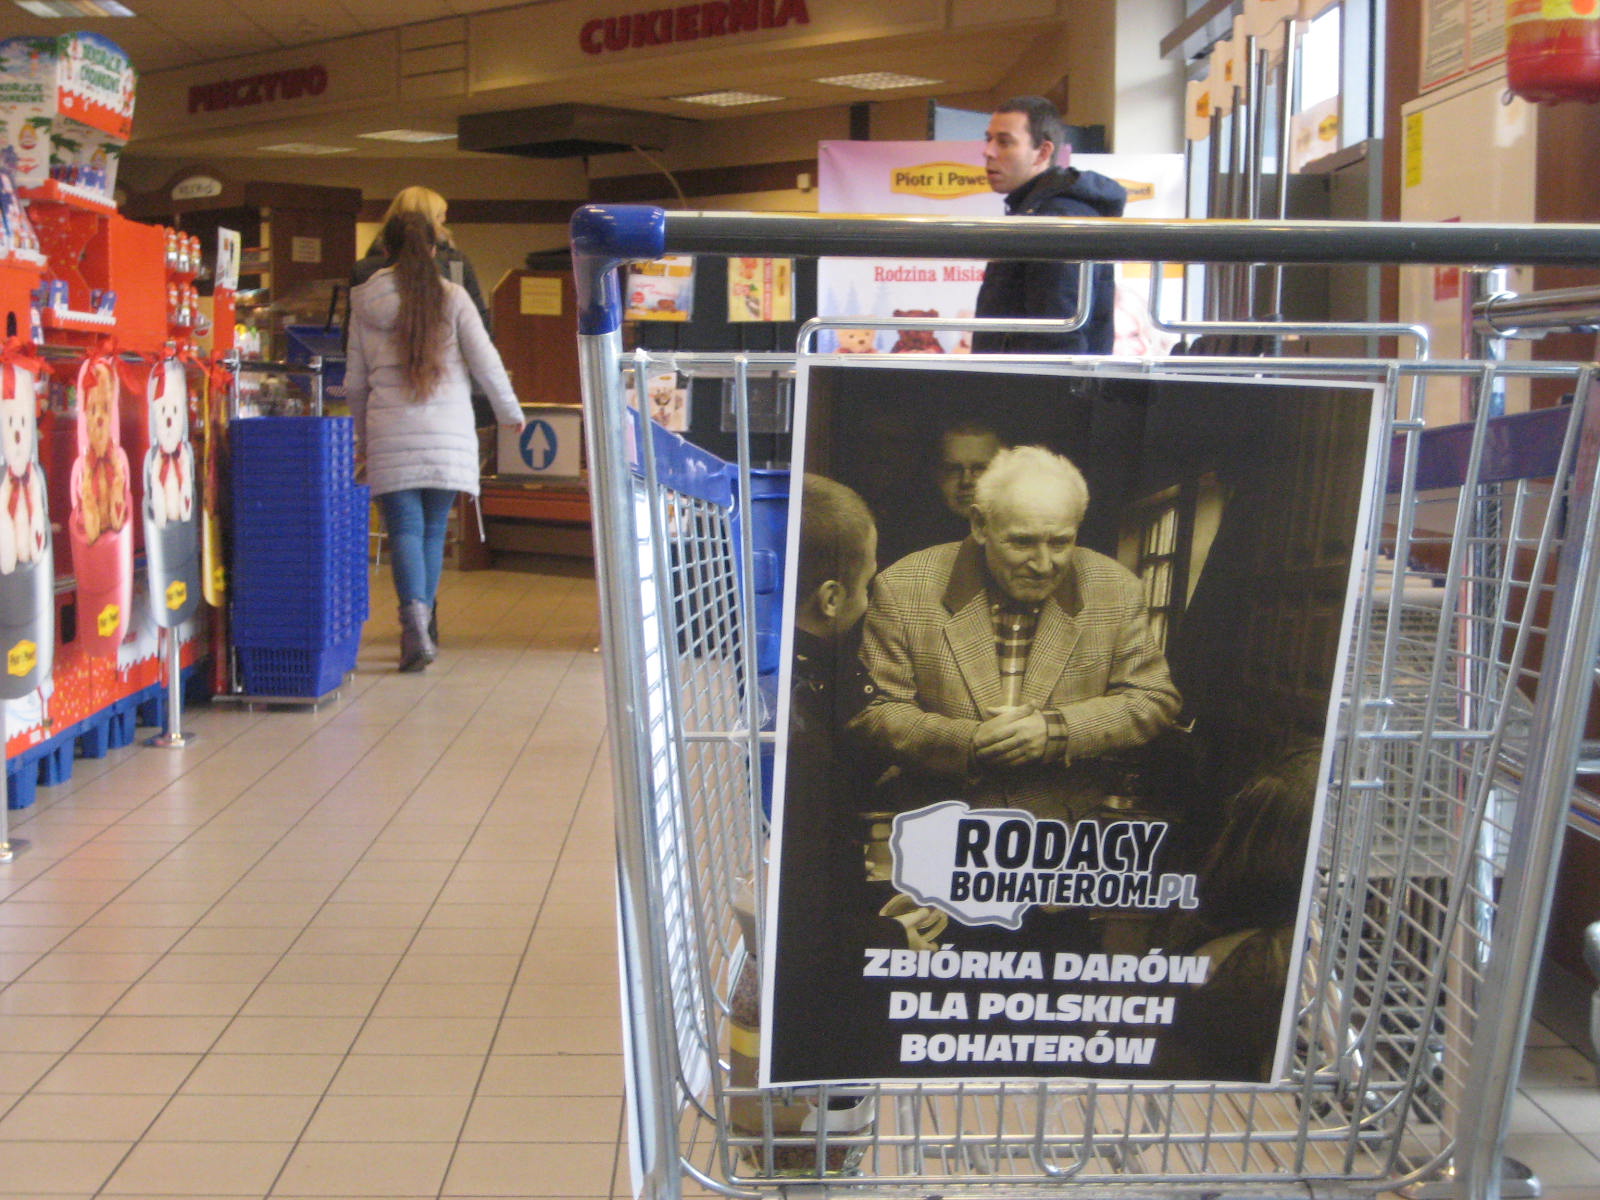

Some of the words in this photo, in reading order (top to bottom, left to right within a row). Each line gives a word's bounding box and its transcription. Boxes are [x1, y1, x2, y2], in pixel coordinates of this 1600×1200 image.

[578, 0, 811, 54] CUKIERNIA
[895, 172, 933, 187] Piotr
[947, 172, 988, 187] Pawe
[874, 265, 937, 282] Rodzina
[954, 818, 1169, 873] RODACY
[863, 943, 1044, 979] ZBIÓRKA
[1053, 949, 1211, 985] DARÓW
[889, 991, 969, 1020] DLA
[978, 993, 1176, 1024] POLSKICH
[900, 1030, 1156, 1065] BOHATERÓW
